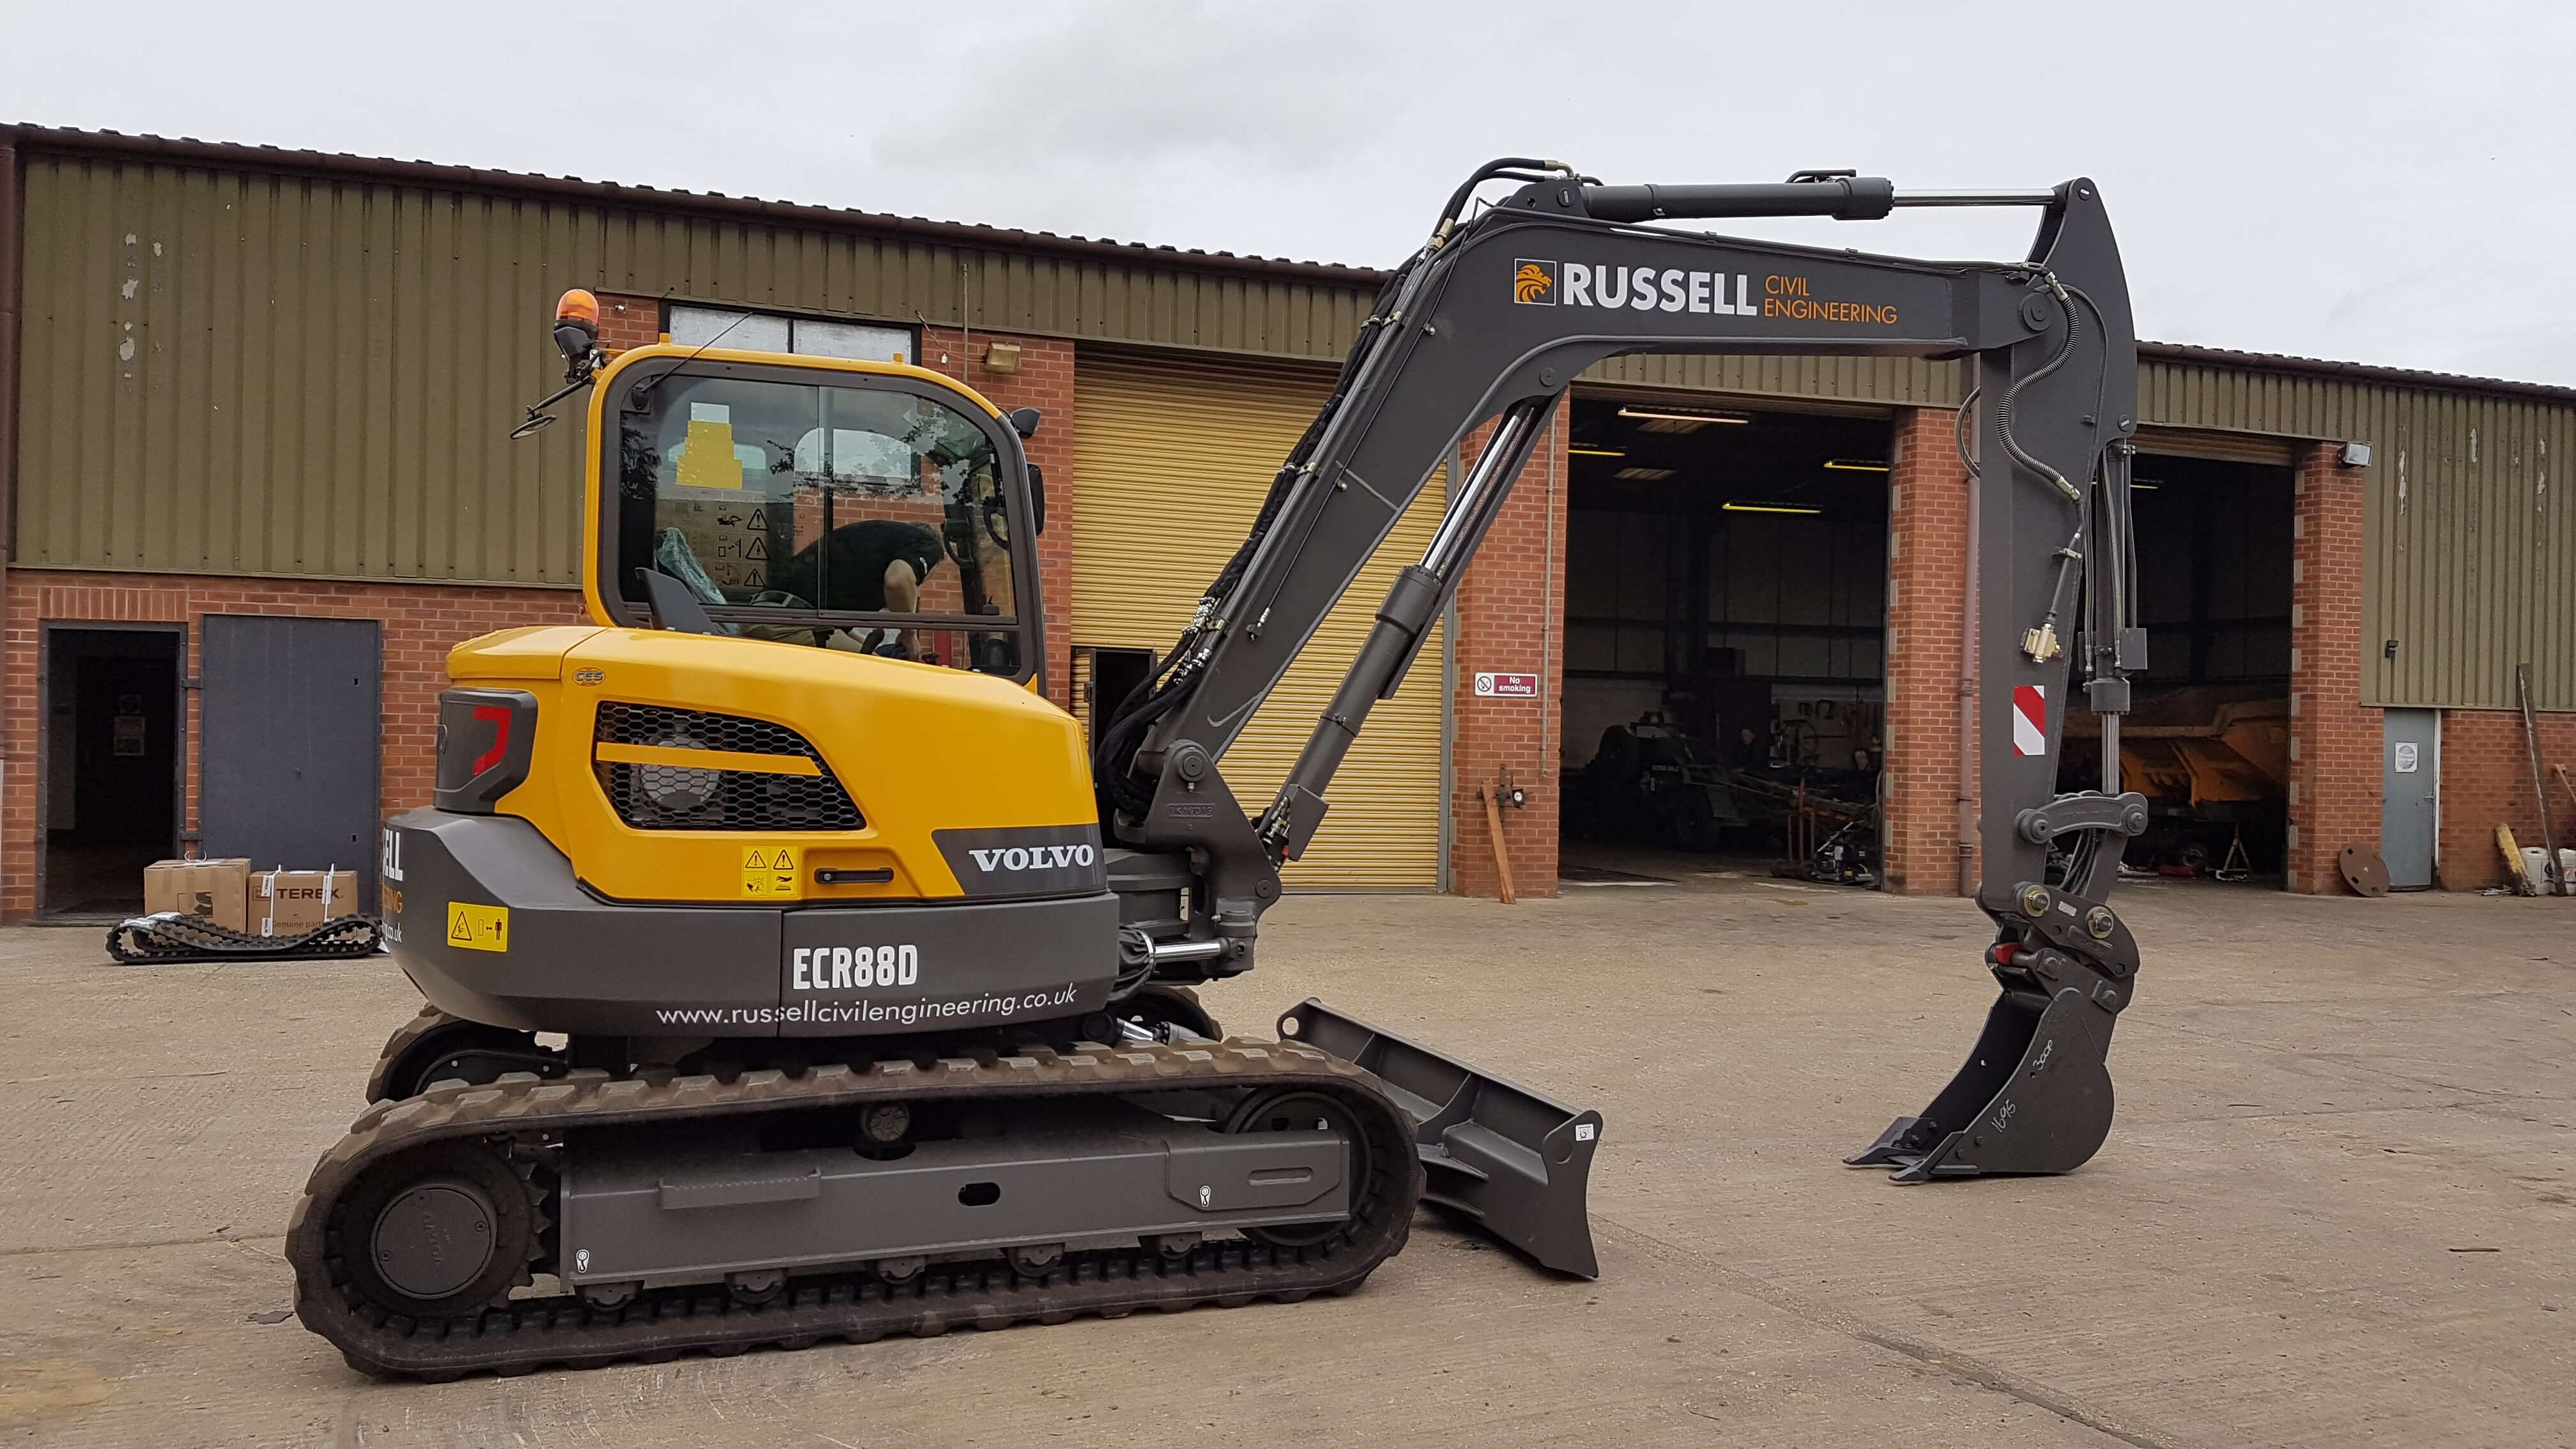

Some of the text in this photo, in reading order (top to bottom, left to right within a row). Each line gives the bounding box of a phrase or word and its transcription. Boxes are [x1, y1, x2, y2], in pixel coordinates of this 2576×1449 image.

[1563, 263, 1757, 316] RUSSELL
[1765, 275, 1809, 296] CIVIL
[1765, 298, 1897, 324] ENGINEERING
[1499, 685, 1531, 694] smoking
[383, 827, 403, 882] ELL
[969, 845, 1094, 872] VOLVO
[276, 888, 341, 899] TEREX
[793, 944, 917, 990] ECR88D
[656, 982, 1077, 1025] www.russellcivilengineering.co.uk
[1991, 1099, 2016, 1133] 1695
